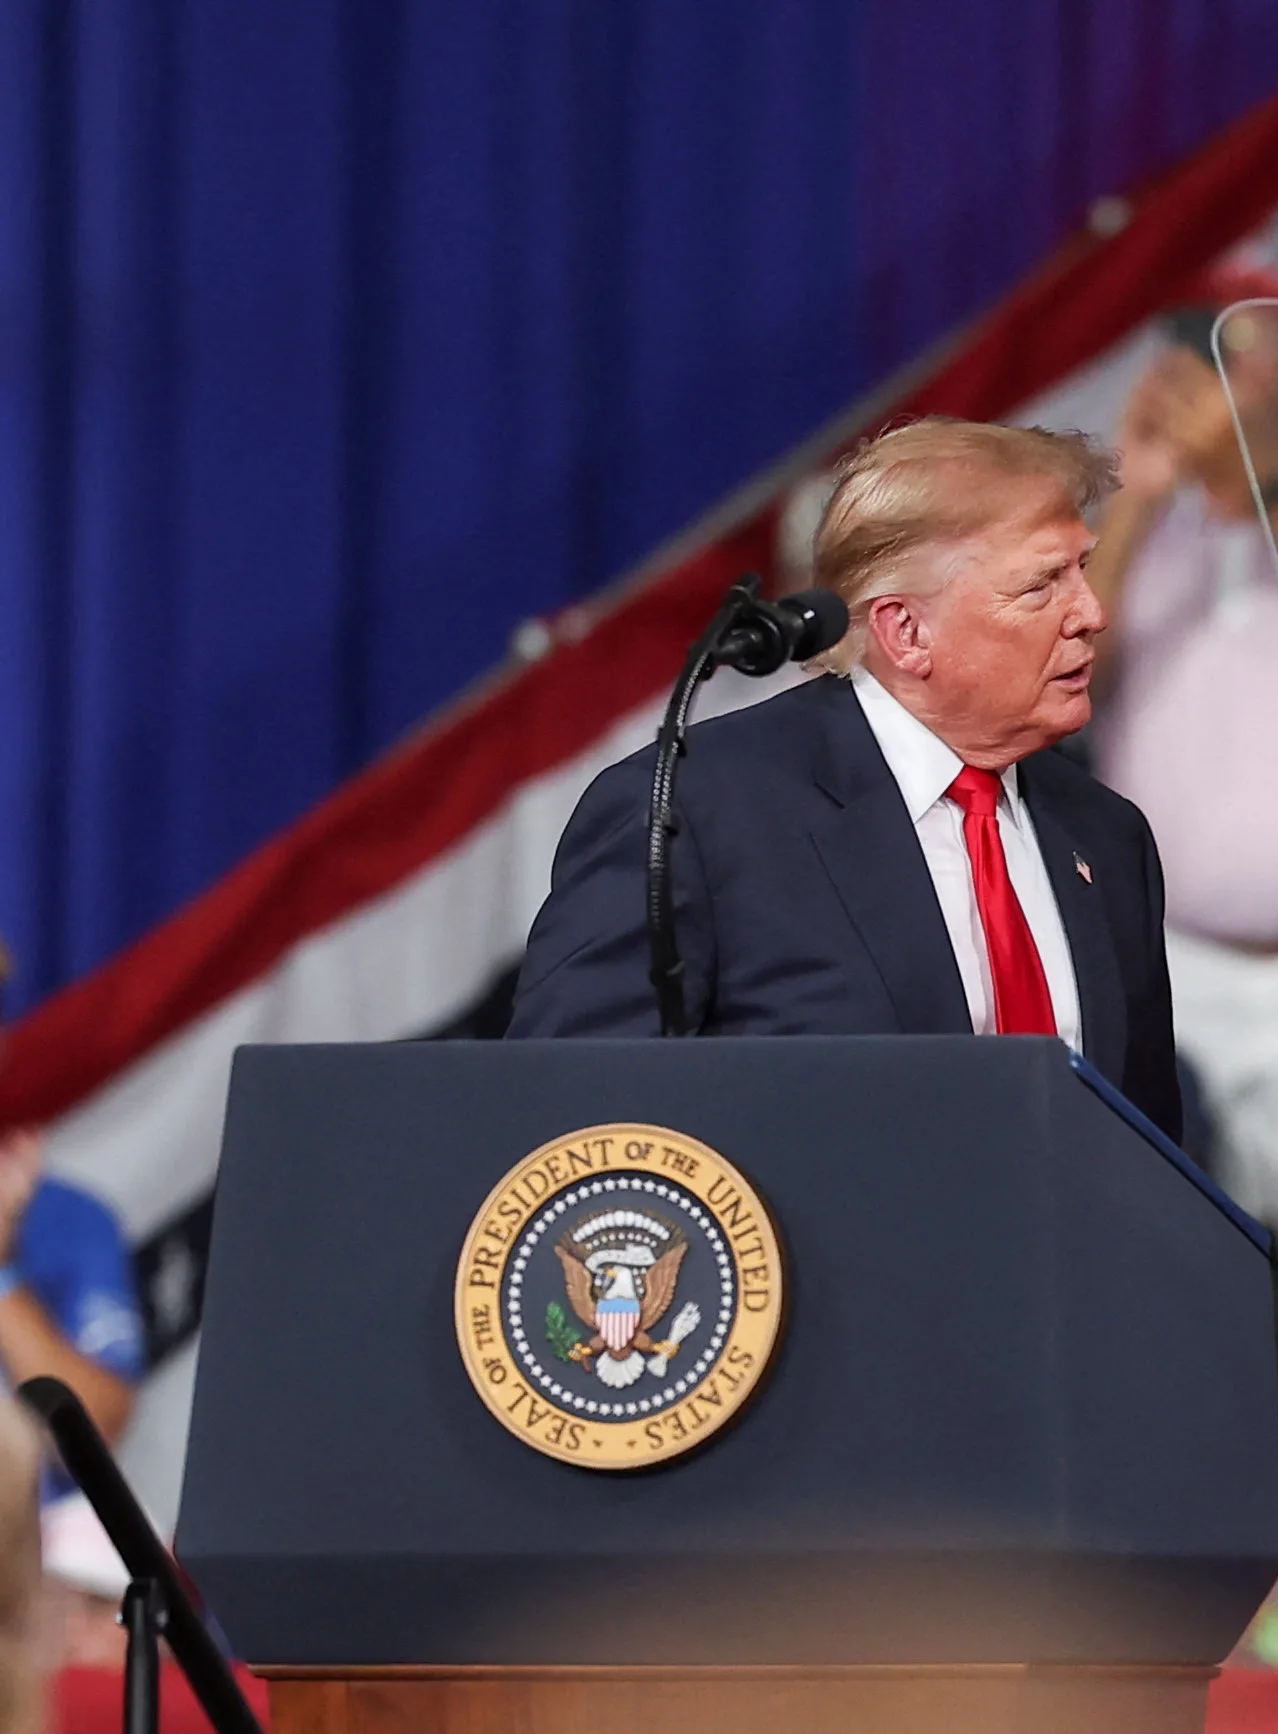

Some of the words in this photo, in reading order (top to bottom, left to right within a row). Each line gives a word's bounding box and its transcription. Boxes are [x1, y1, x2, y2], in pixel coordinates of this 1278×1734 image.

[624, 1140, 654, 1161] OF
[661, 1147, 701, 1178] THE
[470, 1139, 616, 1289] PRESIDENT
[707, 1174, 769, 1313] UNITED
[472, 1305, 493, 1350] THE
[483, 1357, 506, 1385] OF
[645, 1346, 752, 1450] STATES
[504, 1383, 586, 1450] SEAL
